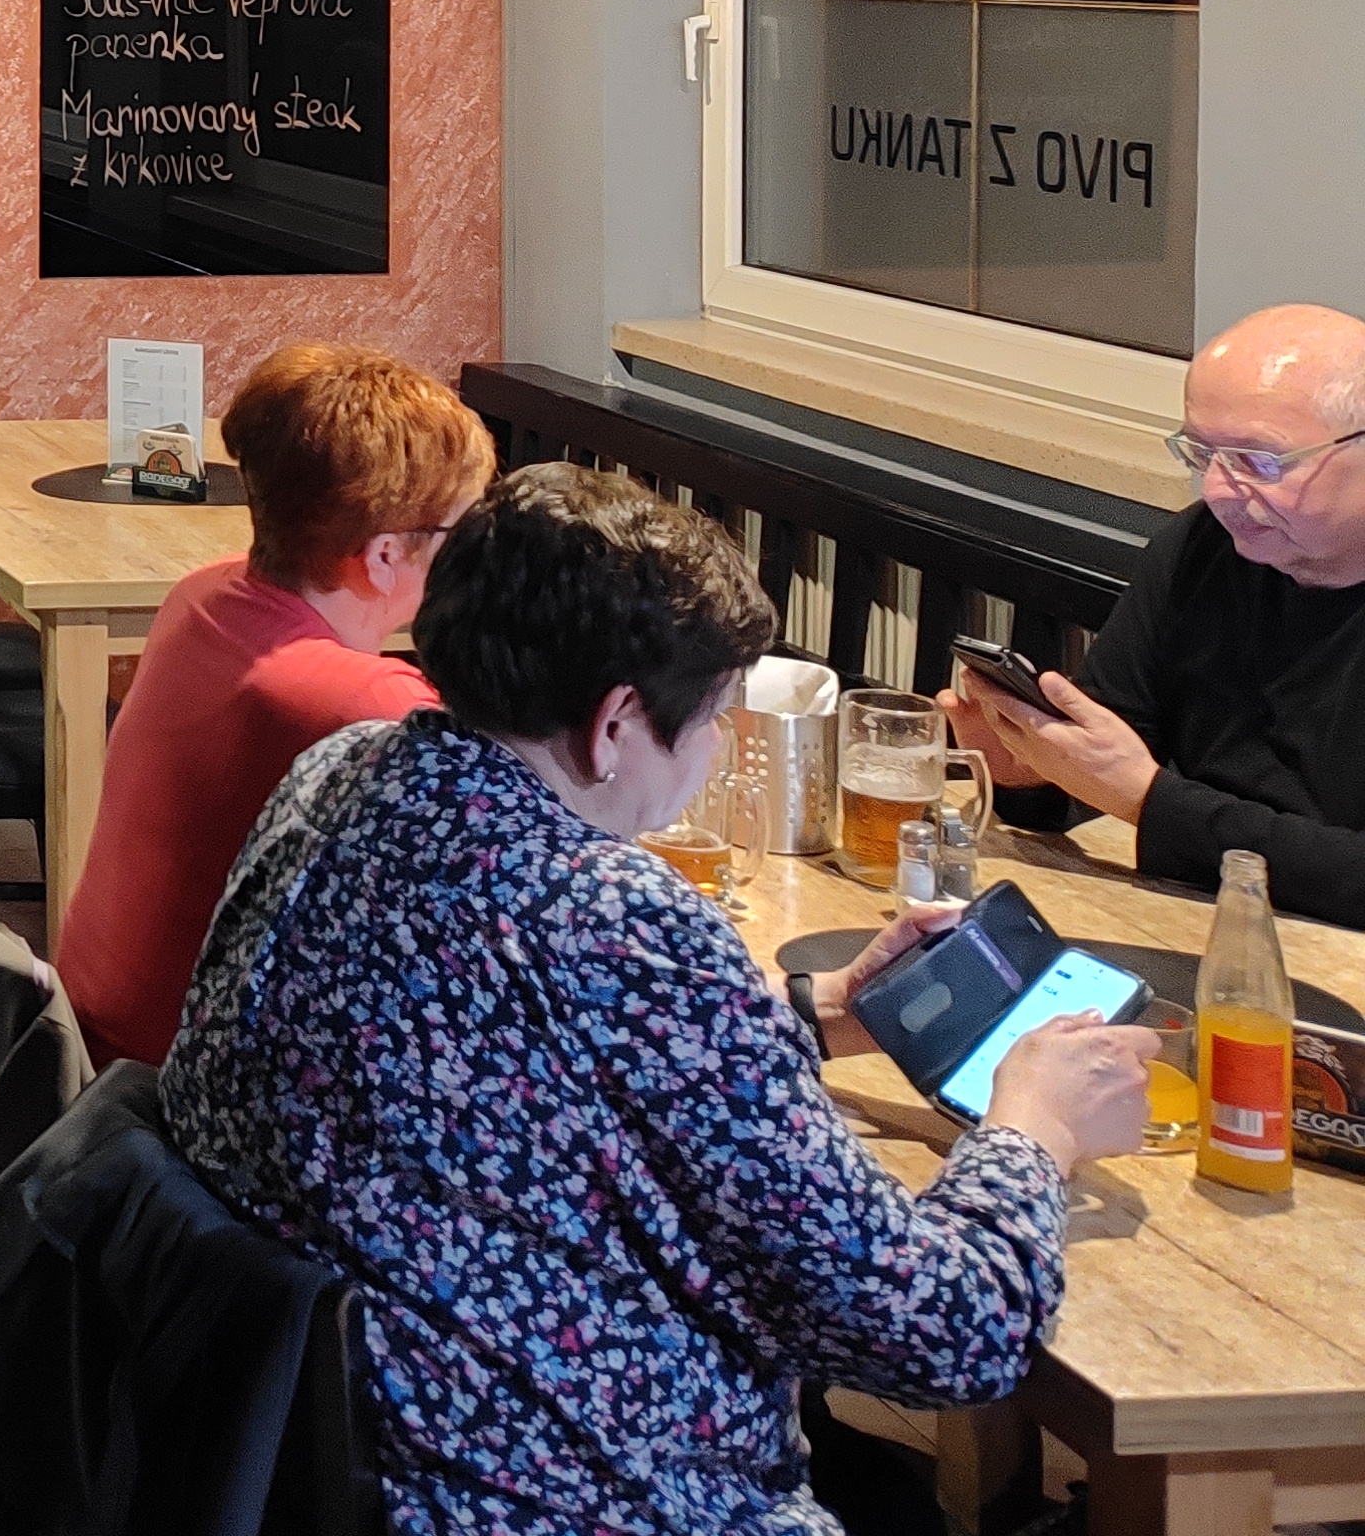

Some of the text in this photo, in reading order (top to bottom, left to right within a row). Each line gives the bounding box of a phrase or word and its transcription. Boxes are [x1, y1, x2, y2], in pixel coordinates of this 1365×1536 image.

[65, 15, 224, 92] panenka
[61, 72, 362, 157] Marinovaný steak
[70, 136, 234, 188] z krkovice
